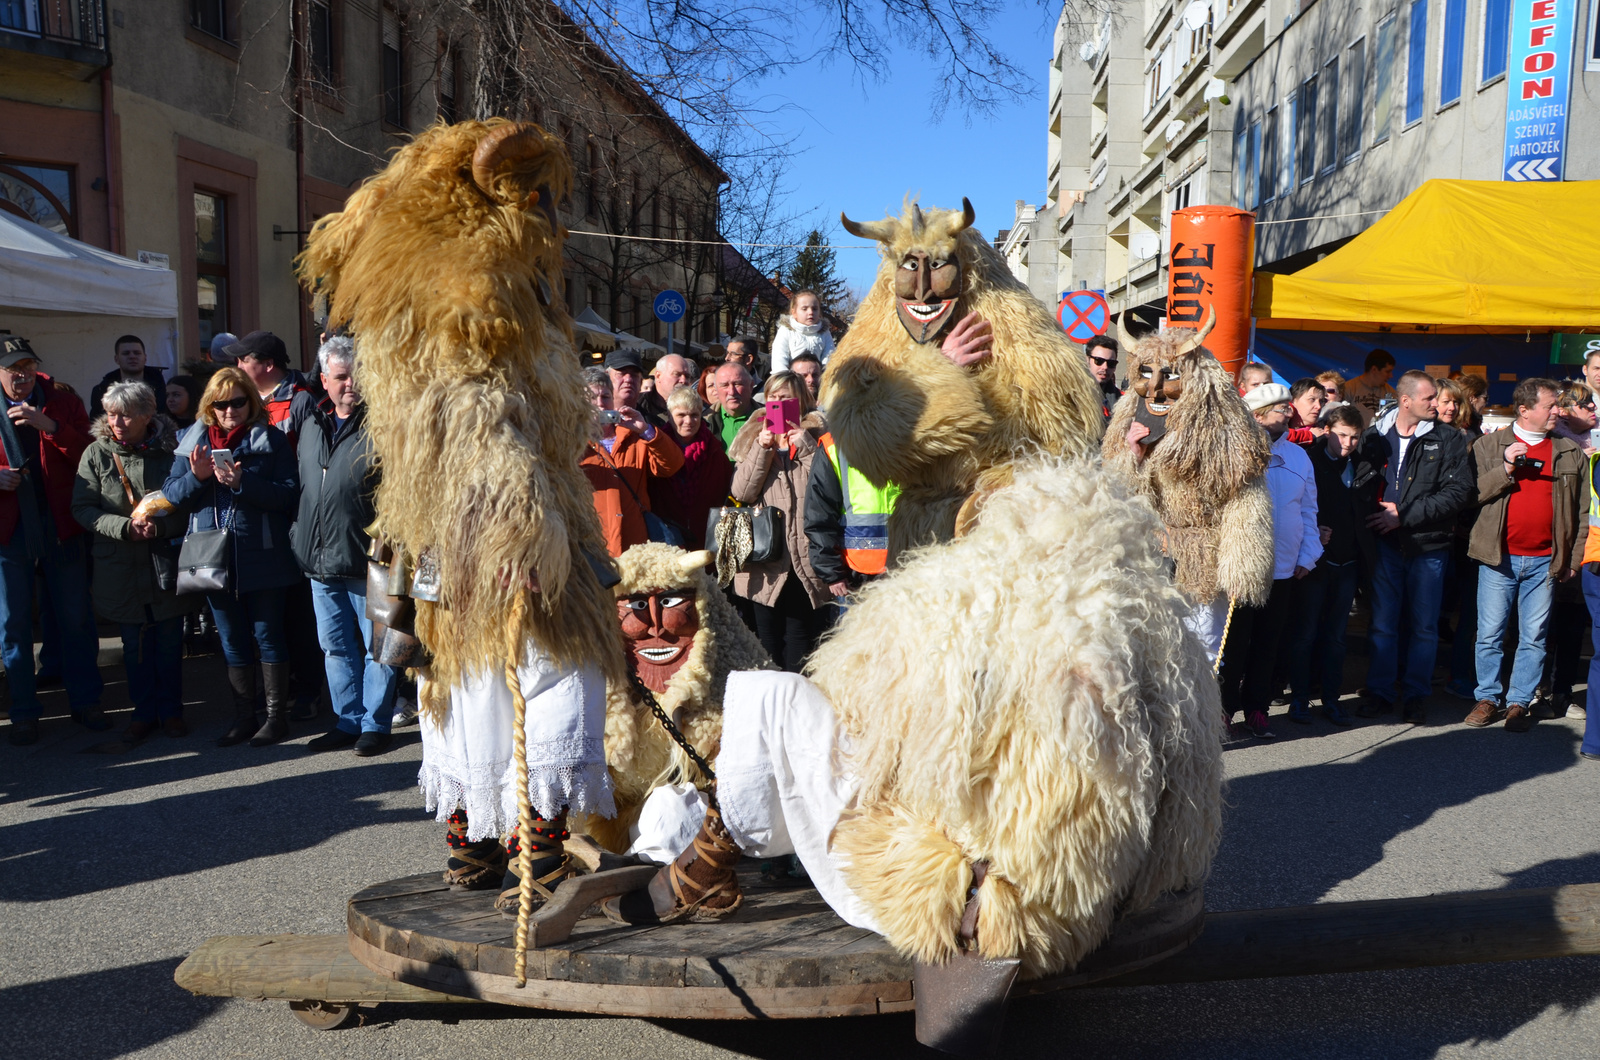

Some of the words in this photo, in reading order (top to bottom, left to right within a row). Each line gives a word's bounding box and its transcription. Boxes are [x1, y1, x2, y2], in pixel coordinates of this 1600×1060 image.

[1508, 103, 1565, 122] ADÁSVÉTEL
[1514, 122, 1557, 139] SZERVIZ
[1509, 138, 1560, 157] TARTOZÉK
[1169, 242, 1216, 331] Jäg
